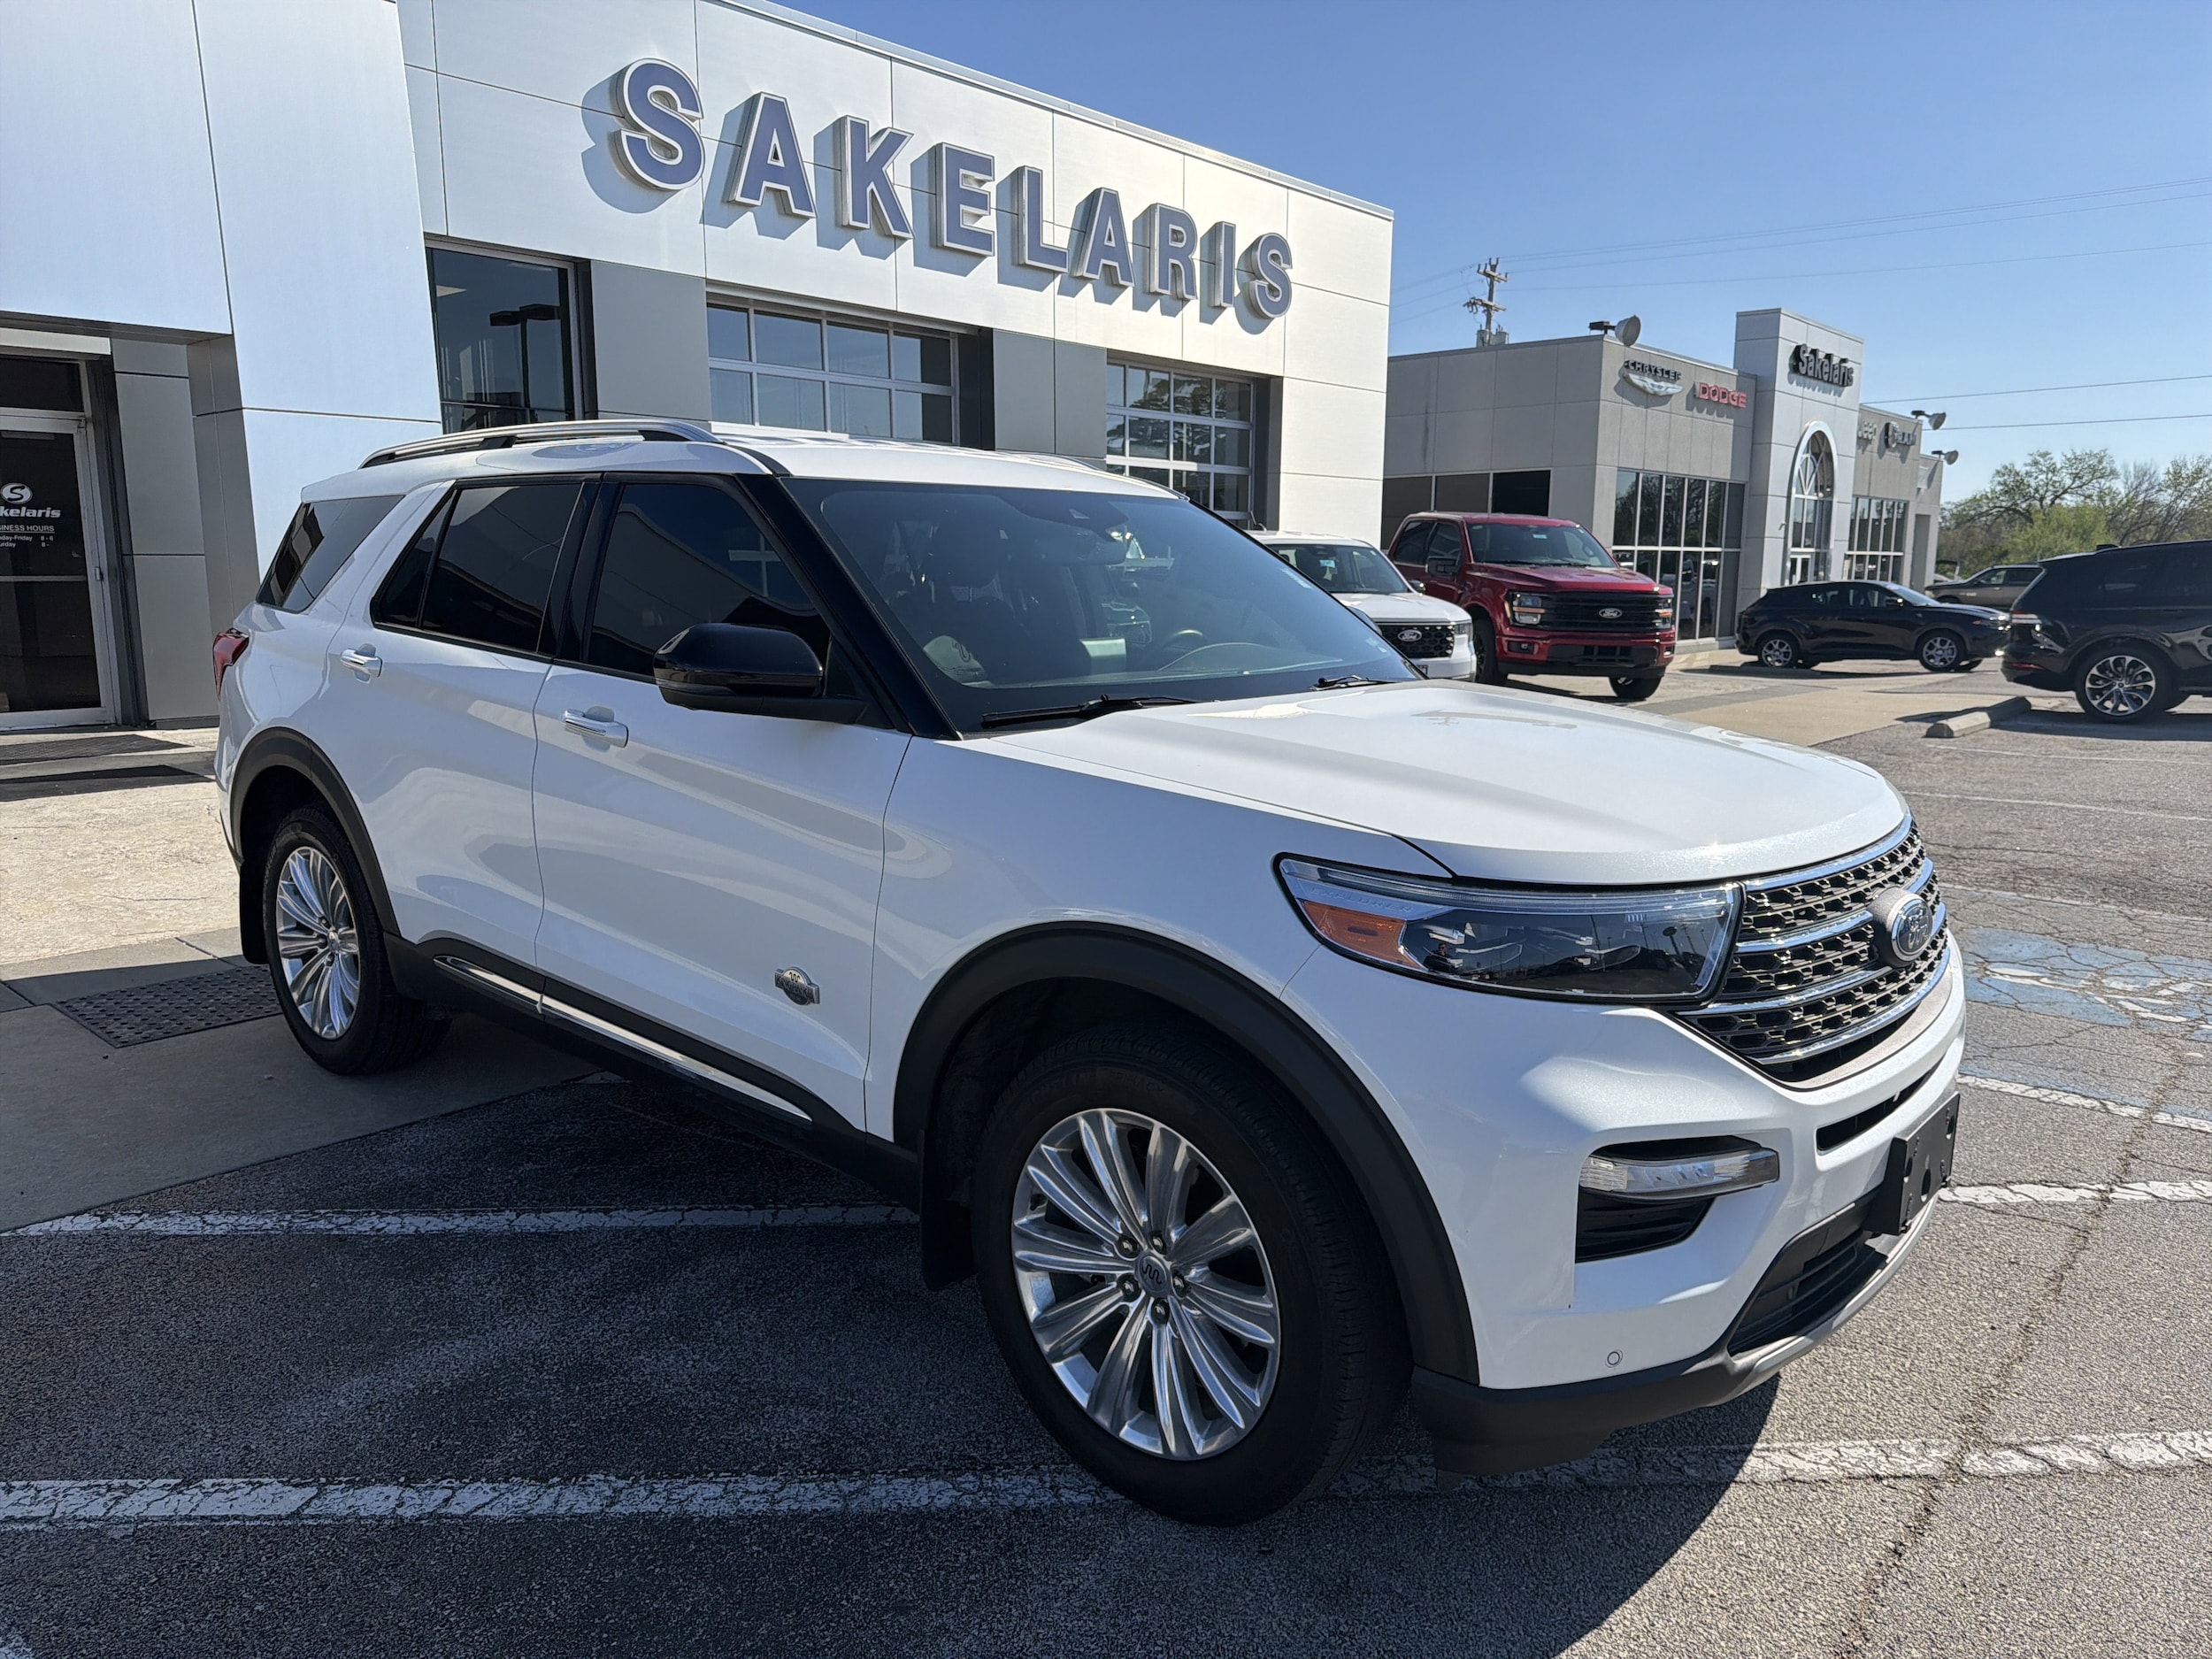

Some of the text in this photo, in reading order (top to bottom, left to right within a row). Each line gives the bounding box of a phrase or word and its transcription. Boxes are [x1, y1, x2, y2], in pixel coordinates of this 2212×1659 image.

[616, 58, 1294, 319] SAKELARIS
[1627, 360, 1681, 380] CHRYSLER
[1798, 343, 1854, 387] Sakelaris
[1699, 382, 1747, 408] DODGE
